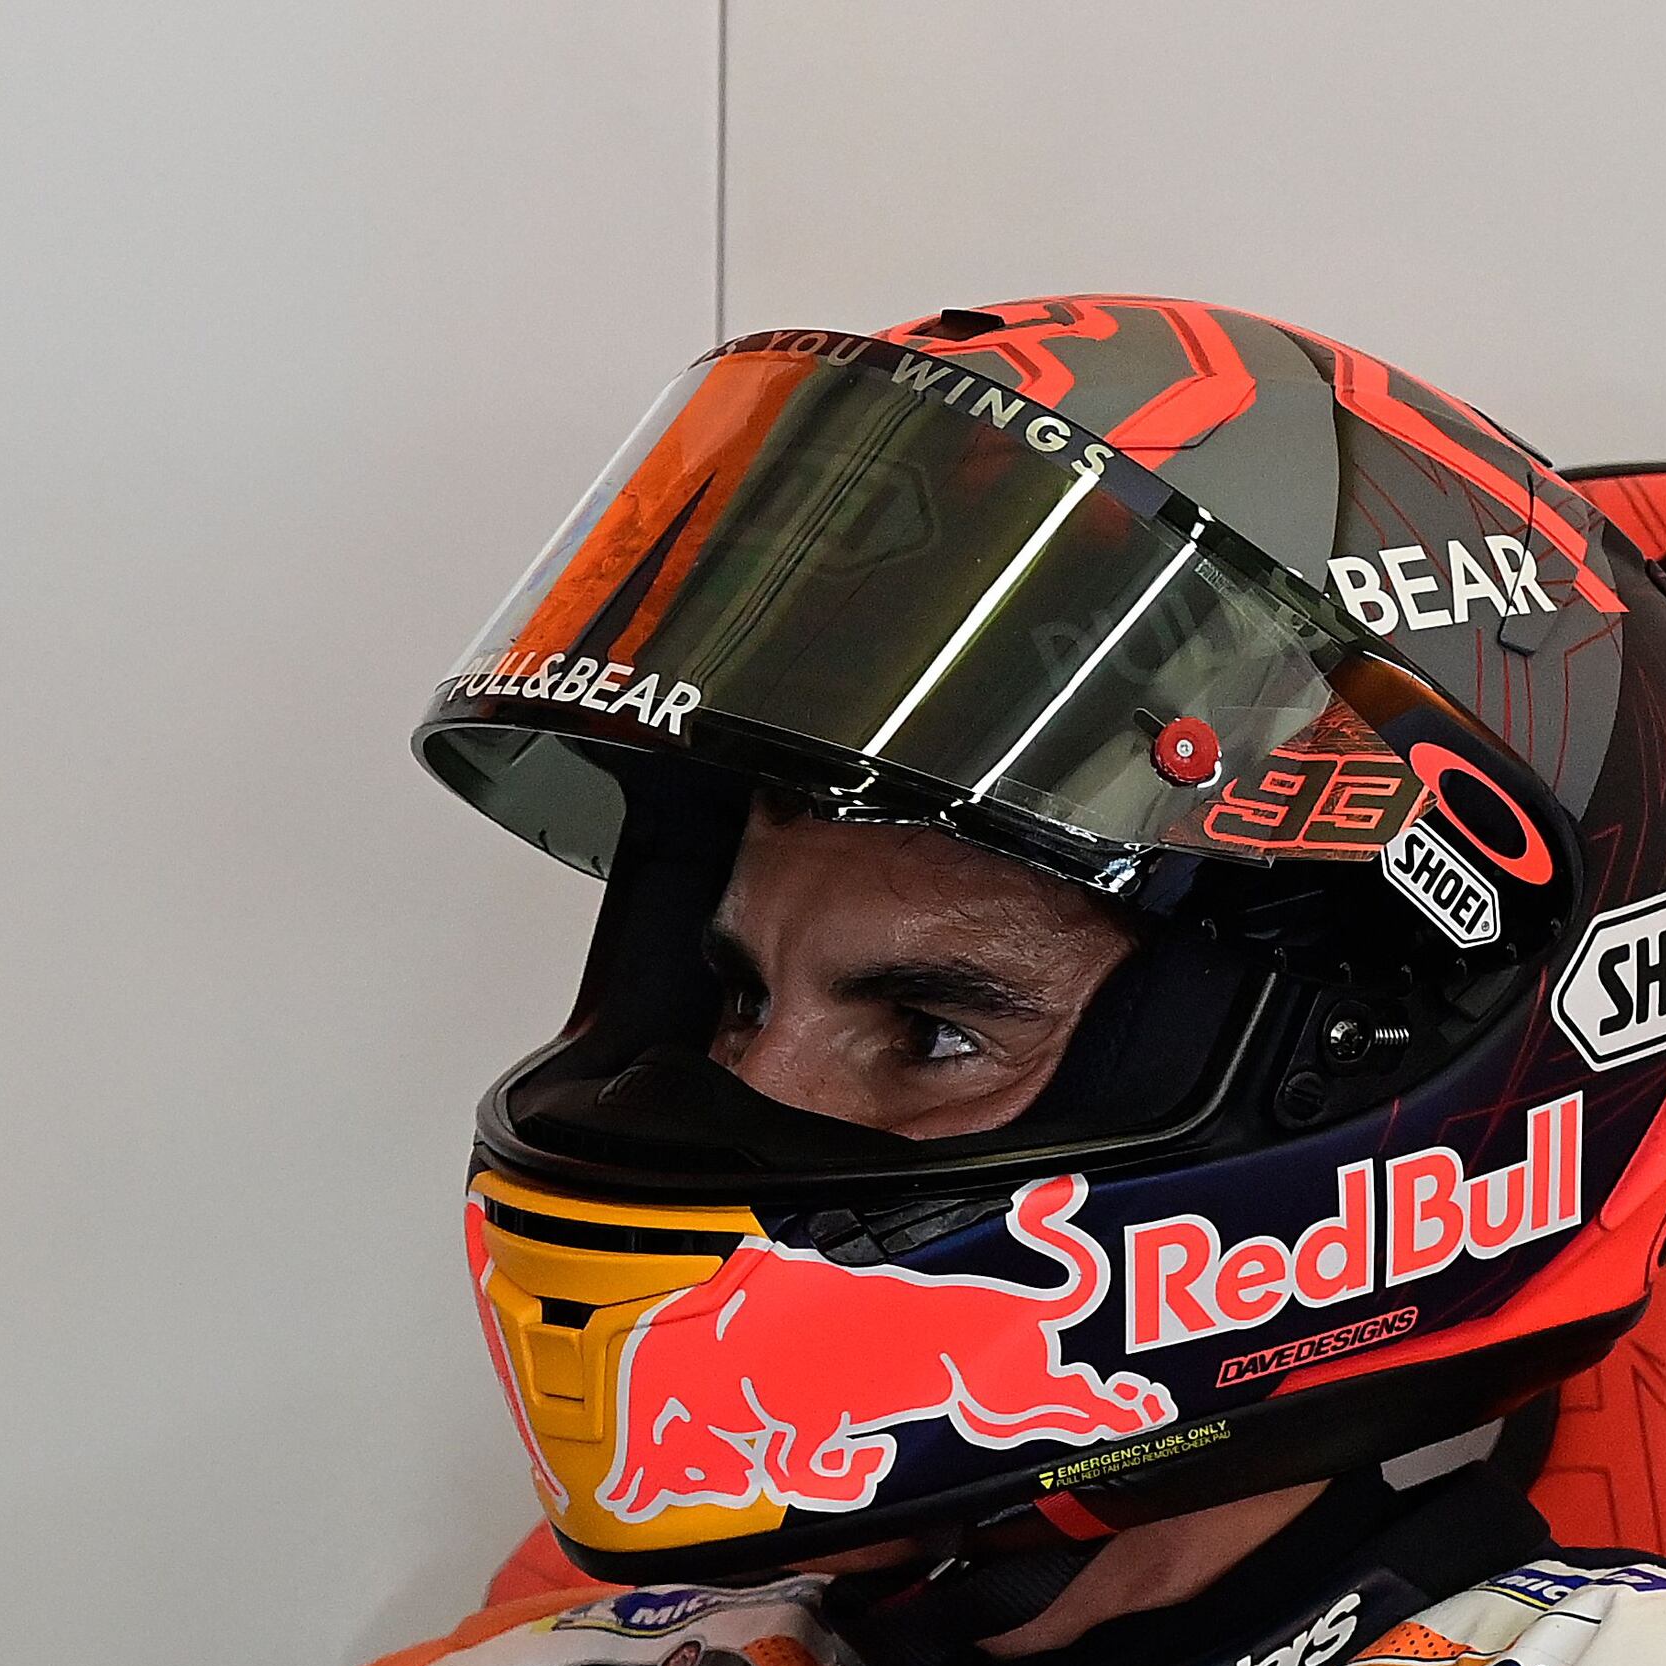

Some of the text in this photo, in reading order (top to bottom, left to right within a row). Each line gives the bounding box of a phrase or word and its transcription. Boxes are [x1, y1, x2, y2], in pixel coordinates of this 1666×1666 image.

[890, 350, 1116, 479] WINGS
[447, 651, 702, 736] PULL&BEAR
[1393, 832, 1489, 936] SHOEI
[1130, 1094, 1580, 1350] Red Bull
[1056, 1474, 1081, 1488] PULL
[1082, 1469, 1101, 1482] RED
[1142, 1446, 1181, 1464] REMOVE
[1057, 1420, 1227, 1478] EMERGENCY USE ONLY
